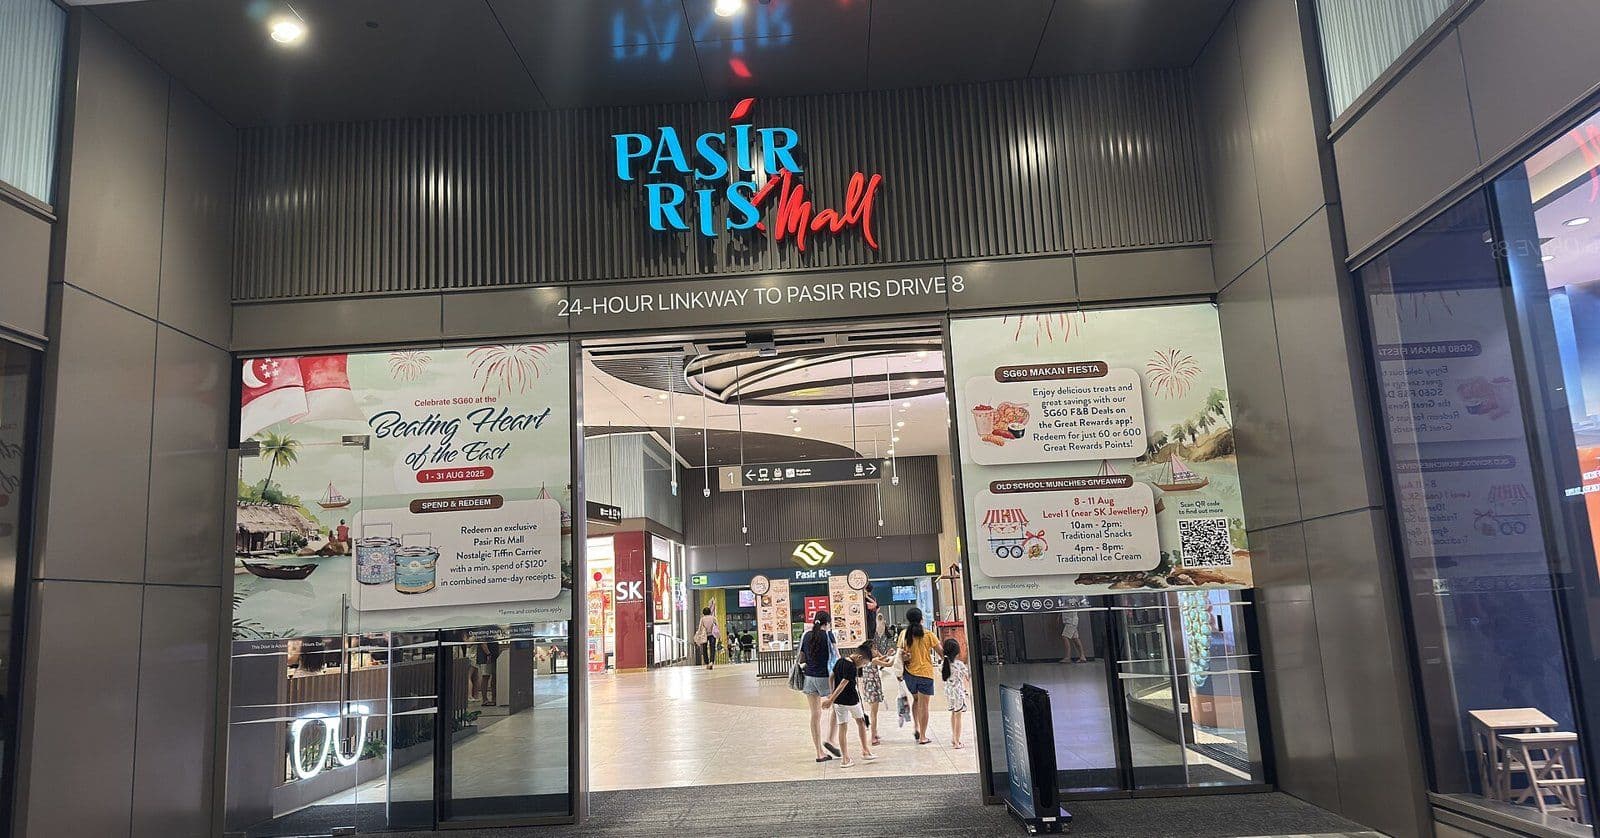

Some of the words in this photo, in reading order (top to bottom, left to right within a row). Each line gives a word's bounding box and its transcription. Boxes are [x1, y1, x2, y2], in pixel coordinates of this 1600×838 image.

[611, 98, 804, 181] PASIR
[643, 181, 760, 237] RIS
[751, 168, 882, 251] Mall
[557, 294, 654, 317] 24-HOUR
[658, 288, 749, 311] LINKWAY
[753, 287, 782, 305] TO
[787, 283, 845, 303] PASIR
[850, 281, 881, 299] RIS
[886, 276, 947, 297] DRIVE
[951, 275, 965, 293] 8
[1003, 370, 1028, 378] SG60
[1029, 367, 1065, 377] MAKAN
[1067, 365, 1100, 375] FIESTA
[1032, 387, 1056, 398] Enjoy
[1057, 386, 1092, 395] delicious
[1093, 385, 1117, 393] treats
[1117, 383, 1133, 391] and
[414, 398, 451, 407] Celebrate
[452, 397, 474, 405] SG60
[484, 395, 497, 403] the
[1041, 400, 1062, 409] great
[1063, 398, 1092, 407] savings
[1094, 396, 1111, 404] with
[1043, 408, 1068, 417] SG60
[1070, 407, 1089, 416] F&B
[1091, 406, 1114, 415] Deals
[368, 410, 462, 445] Beating
[466, 407, 551, 433] Heart
[1038, 421, 1052, 429] the
[1054, 420, 1077, 428] Great
[1079, 418, 1114, 427] Rewards
[1115, 416, 1133, 426] app!
[1033, 432, 1066, 441] Redeem
[1068, 431, 1080, 440] for
[1081, 431, 1097, 441] just
[1098, 429, 1110, 437] 60
[1122, 427, 1141, 436] 600
[1043, 443, 1066, 452] Great
[1069, 441, 1102, 451] Rewards
[1104, 440, 1133, 449] Points!
[405, 444, 431, 471] of
[431, 443, 458, 464] the
[461, 441, 511, 463] East
[425, 473, 430, 481] 1
[435, 472, 445, 480] 31
[446, 471, 464, 479] AUG
[465, 470, 485, 478] 2025
[727, 472, 734, 484] 1
[1045, 480, 1086, 488] MUNCHIES
[1087, 478, 1126, 486] GIVEAWAY
[421, 501, 449, 509] SPEND
[450, 500, 457, 508] &
[458, 498, 491, 507] REDEEM
[1074, 497, 1080, 506] 8
[1087, 497, 1095, 505] 11
[1097, 496, 1115, 507] Aug
[1195, 500, 1205, 508] QR
[1042, 510, 1064, 519] Level
[1065, 510, 1069, 518] 1
[1071, 508, 1092, 518] (near
[1093, 508, 1106, 516] SK
[1108, 506, 1149, 517] Jewellery)
[460, 526, 492, 534] Redeem
[504, 522, 538, 532] exclusive
[1070, 521, 1093, 530] 10am
[1101, 520, 1122, 531] 2pm:
[473, 538, 492, 547] Pasir
[494, 537, 506, 545] Ris
[507, 535, 525, 544] Mall
[1060, 531, 1102, 540] Traditional
[1105, 530, 1132, 538] Snacks
[456, 550, 492, 561] Nostalgic
[493, 549, 513, 558] Tiffin
[515, 547, 541, 556] Carrier
[1074, 544, 1094, 554] 4pm
[1102, 543, 1124, 554] 8pm:
[1056, 555, 1098, 563] Traditional
[1114, 553, 1142, 561] Cream
[450, 564, 467, 573] with
[473, 563, 490, 571] min.
[491, 562, 514, 573] spend
[515, 560, 525, 569] of
[440, 578, 448, 587] in
[449, 576, 487, 586] combined
[487, 574, 524, 585] same-day
[525, 572, 556, 583] receipts.
[795, 569, 816, 579] Pasir
[616, 580, 643, 600] SK
